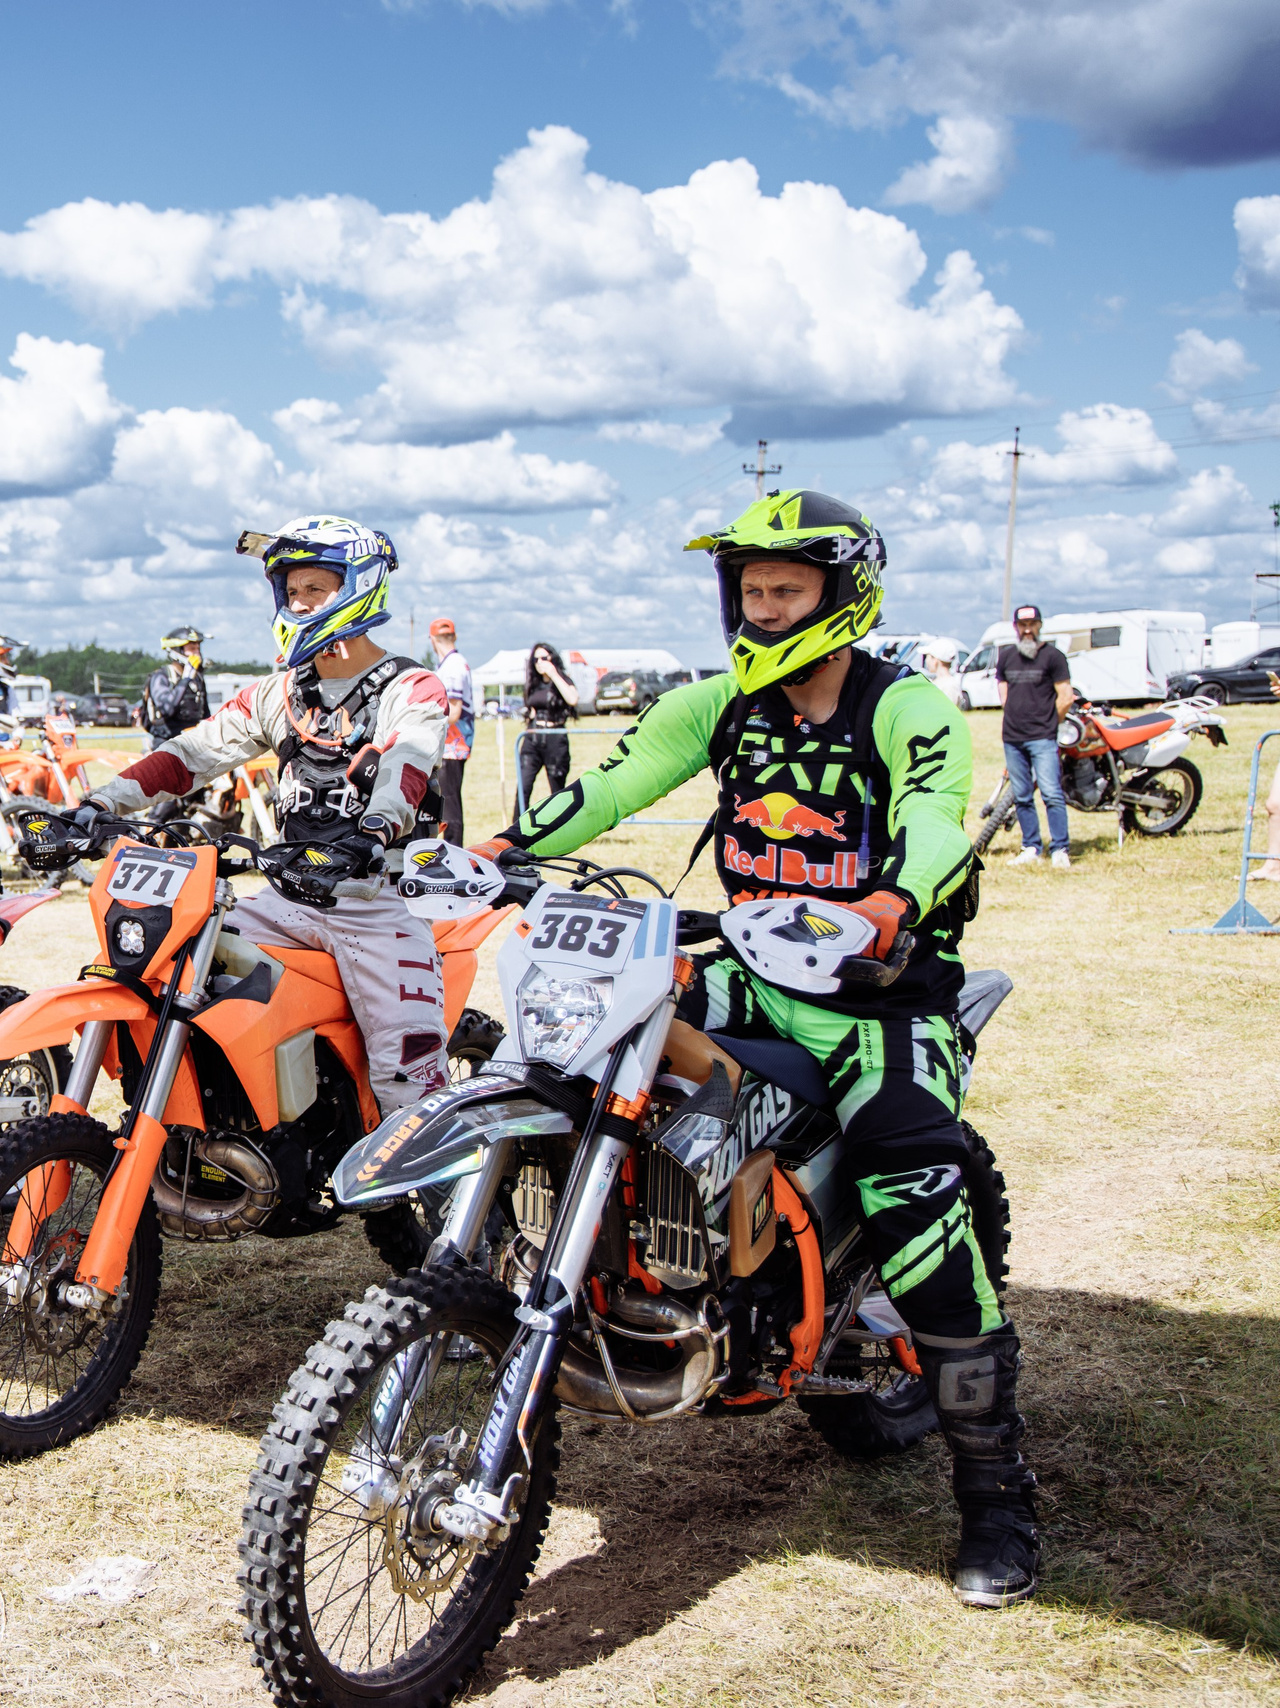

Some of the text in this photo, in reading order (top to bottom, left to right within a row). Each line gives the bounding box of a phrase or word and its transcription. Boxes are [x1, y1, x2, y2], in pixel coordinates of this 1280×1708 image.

[343, 538, 392, 559] 100%
[34, 844, 57, 853] CYCRA
[723, 834, 859, 889] Red Bull
[112, 862, 176, 898] 371
[424, 884, 455, 894] CYCRA
[531, 913, 628, 959] 383
[480, 1061, 506, 1074] XO
[422, 1089, 453, 1113] TO
[373, 1114, 424, 1164] RACE
[697, 1082, 792, 1205] HOLY GAS
[201, 1172, 226, 1183] ELEMENT
[602, 1151, 618, 1179] XACT
[479, 1388, 509, 1469] HOLY
